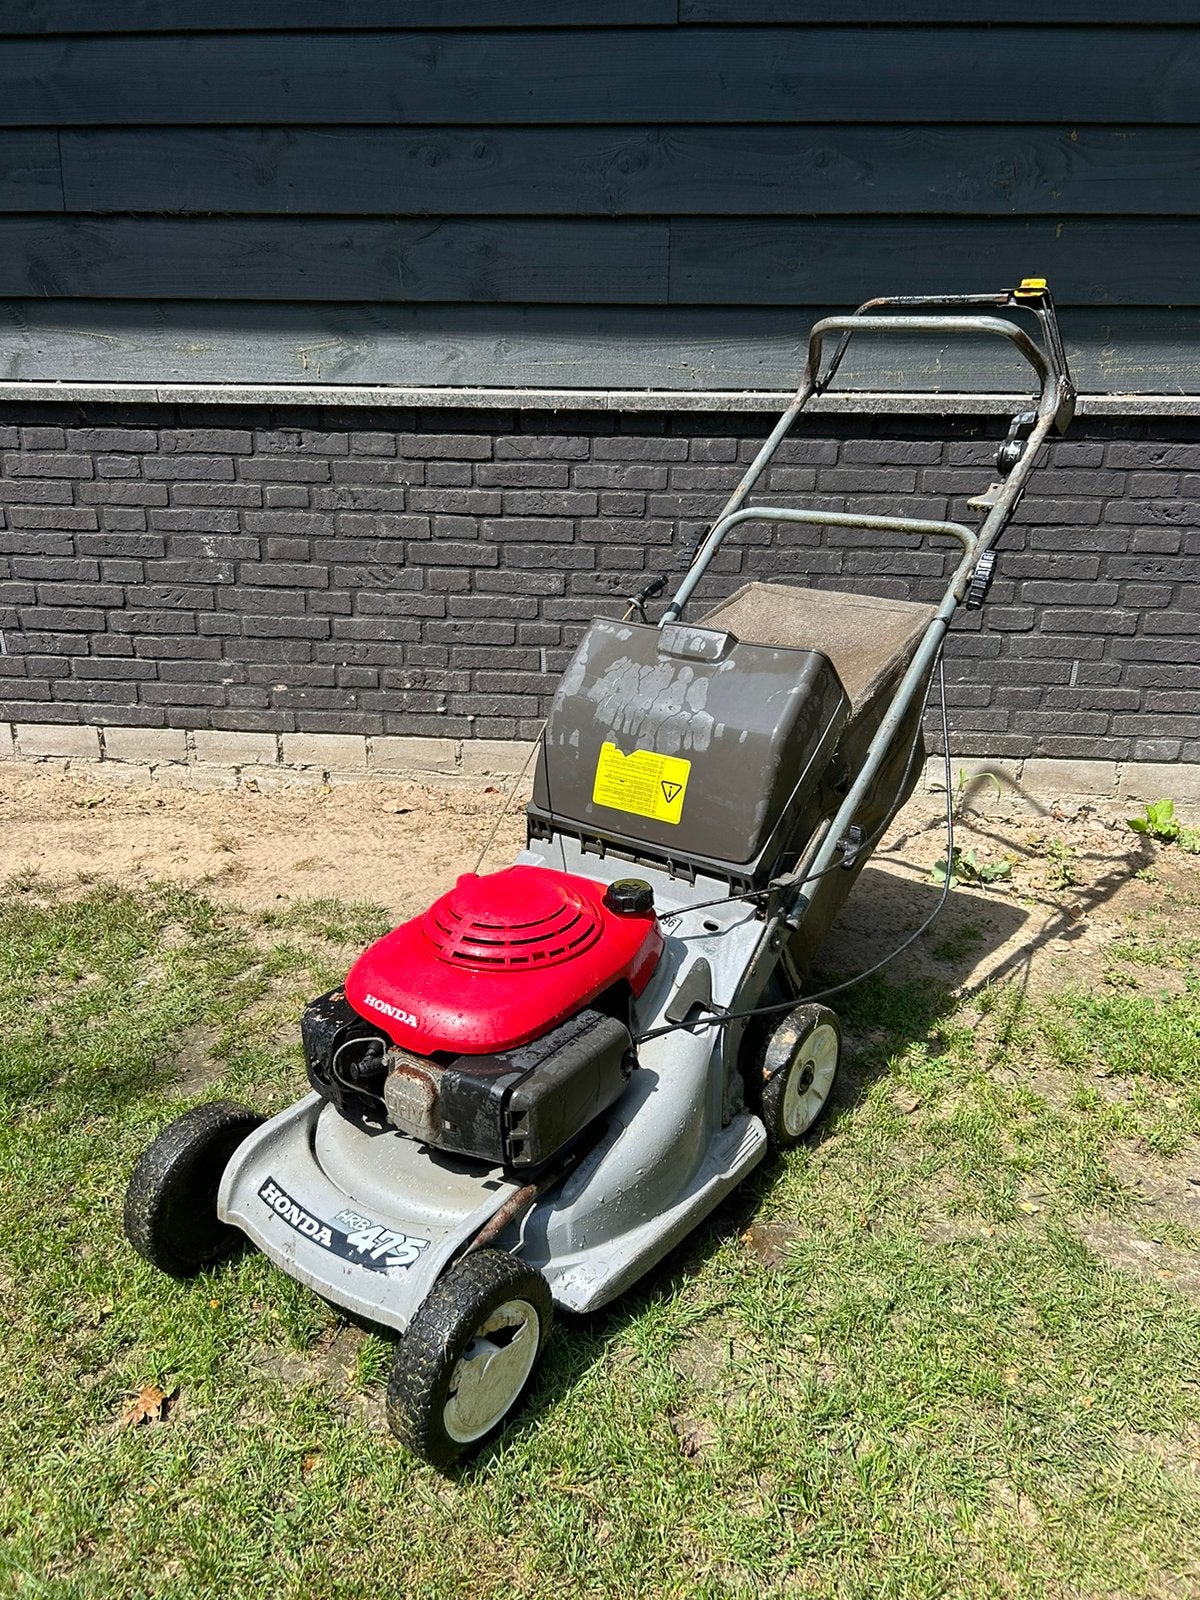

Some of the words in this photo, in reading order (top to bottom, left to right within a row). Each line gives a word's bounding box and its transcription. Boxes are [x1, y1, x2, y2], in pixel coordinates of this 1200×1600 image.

[661, 916, 677, 927] 96
[363, 993, 418, 1029] HONDA
[260, 1182, 333, 1248] HONDA
[334, 1209, 372, 1232] HRB
[346, 1224, 432, 1267] 475
